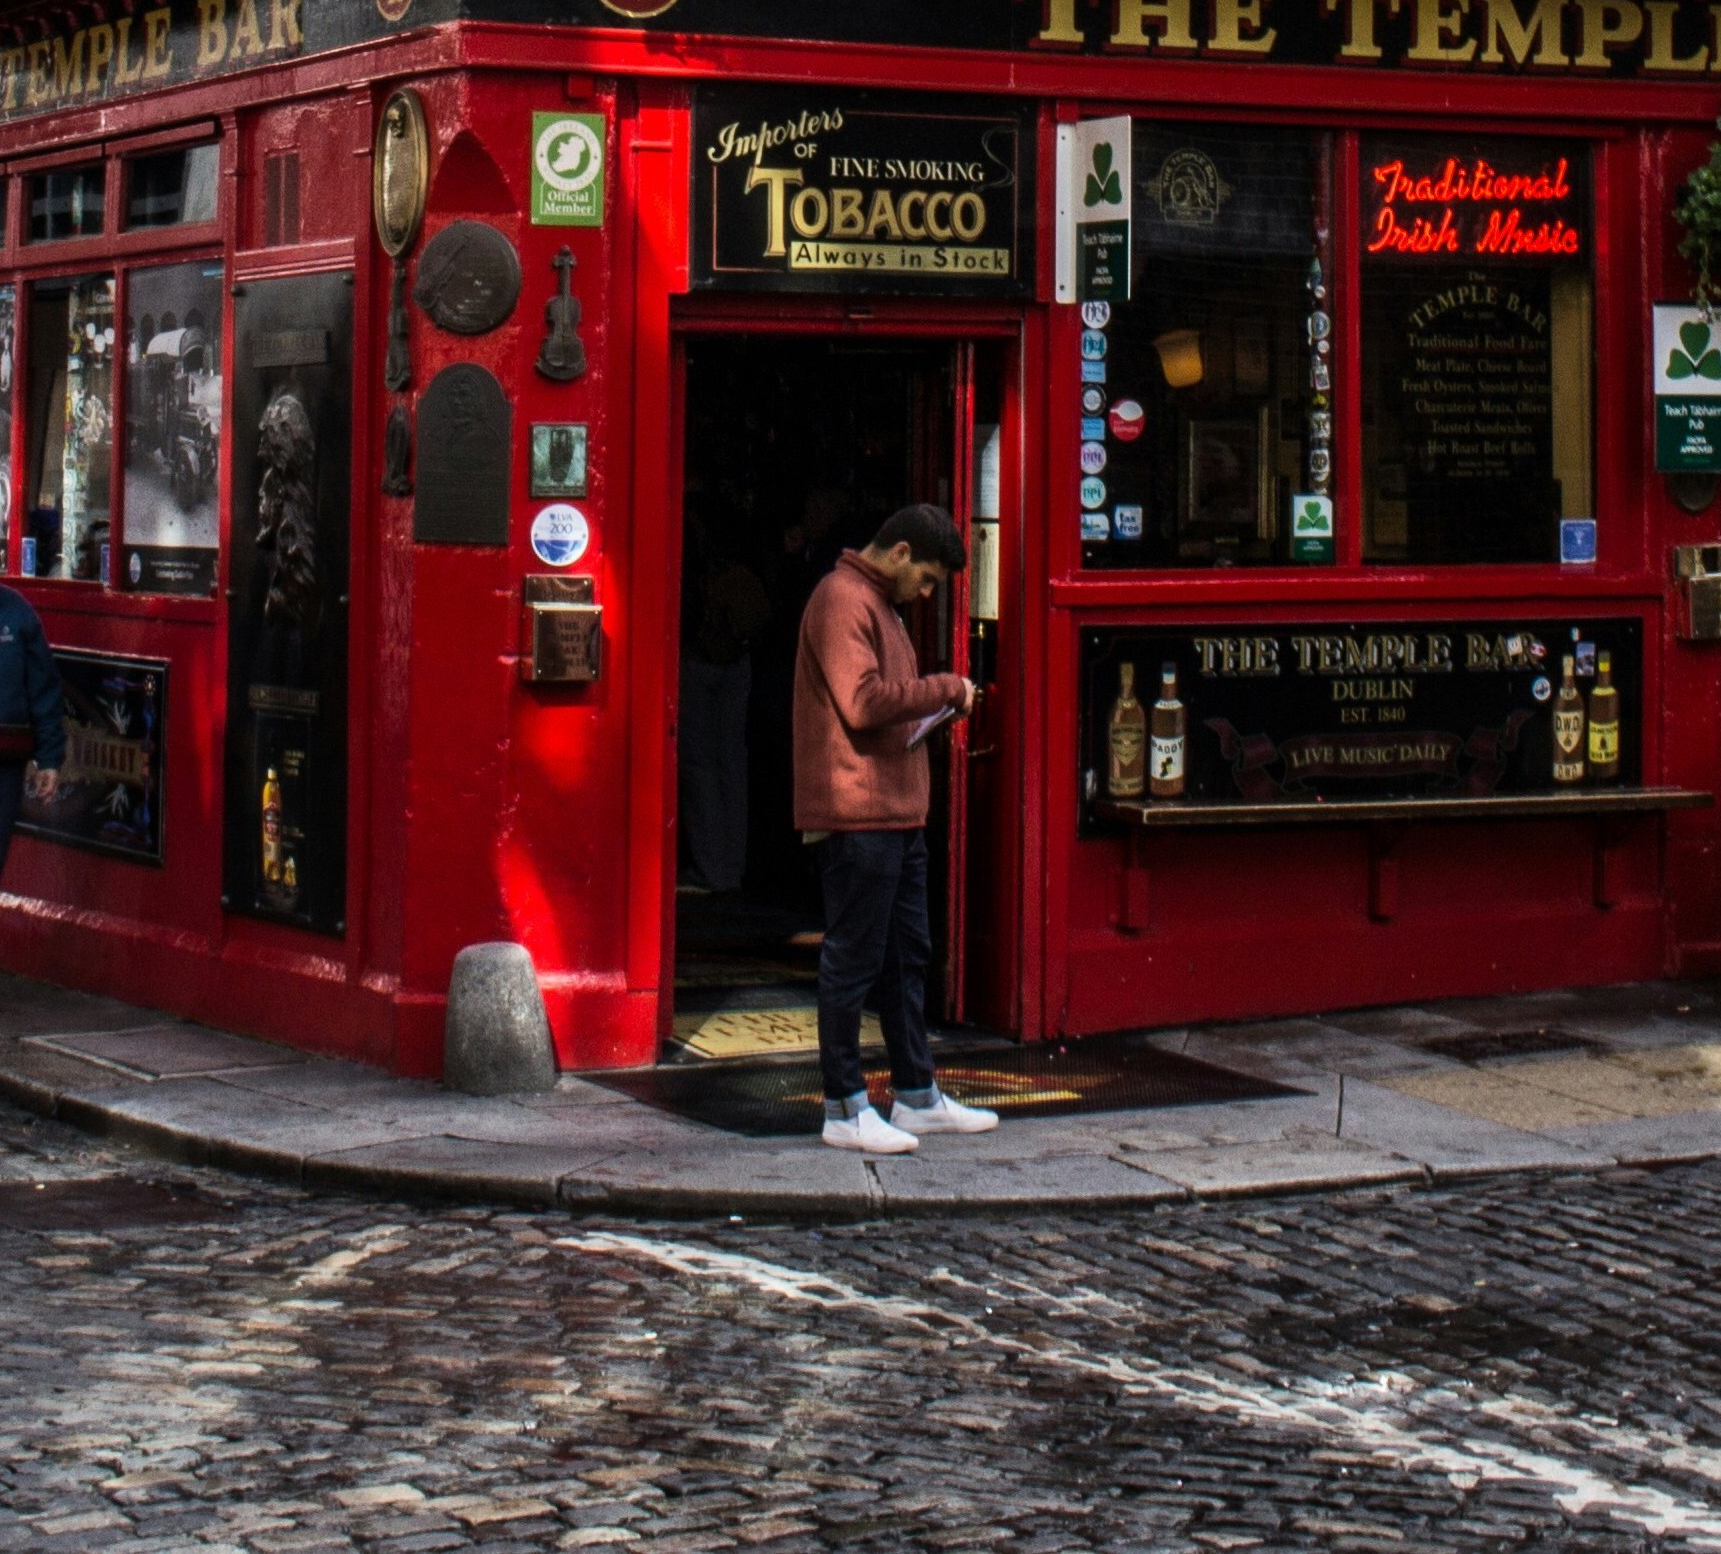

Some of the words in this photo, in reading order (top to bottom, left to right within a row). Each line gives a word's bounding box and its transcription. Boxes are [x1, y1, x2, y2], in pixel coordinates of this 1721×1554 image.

[0, 7, 172, 108] TEMPLE
[707, 107, 843, 165] Importers
[794, 143, 817, 159] OF
[830, 156, 879, 178] FINE
[884, 159, 985, 183] SMOKING
[1374, 159, 1569, 202] Traditional
[547, 190, 589, 202] Official
[544, 202, 592, 214] Member
[744, 165, 987, 257] TOBACCO
[1368, 206, 1458, 252] Irish
[1476, 209, 1578, 253] Music
[795, 243, 886, 267] Always
[901, 245, 922, 265] in
[933, 247, 1007, 271] Stock
[1409, 285, 1498, 329] TEMPLE
[1507, 294, 1548, 332] BAR
[1409, 334, 1479, 349] Traditional
[1664, 404, 1688, 416] Teach
[1689, 419, 1705, 431] Pub
[1120, 512, 1136, 523] tax
[1120, 523, 1139, 534] free
[1194, 636, 1281, 677] THE
[1292, 634, 1453, 675] TEMPLE
[1465, 632, 1546, 673] BAR
[1331, 679, 1415, 702] DUBLIN
[1340, 707, 1373, 723] EST.
[1378, 706, 1407, 723] 1840
[1291, 747, 1334, 766] LIVE
[1340, 746, 1394, 765] MUSIC
[1399, 744, 1452, 764] DAILY
